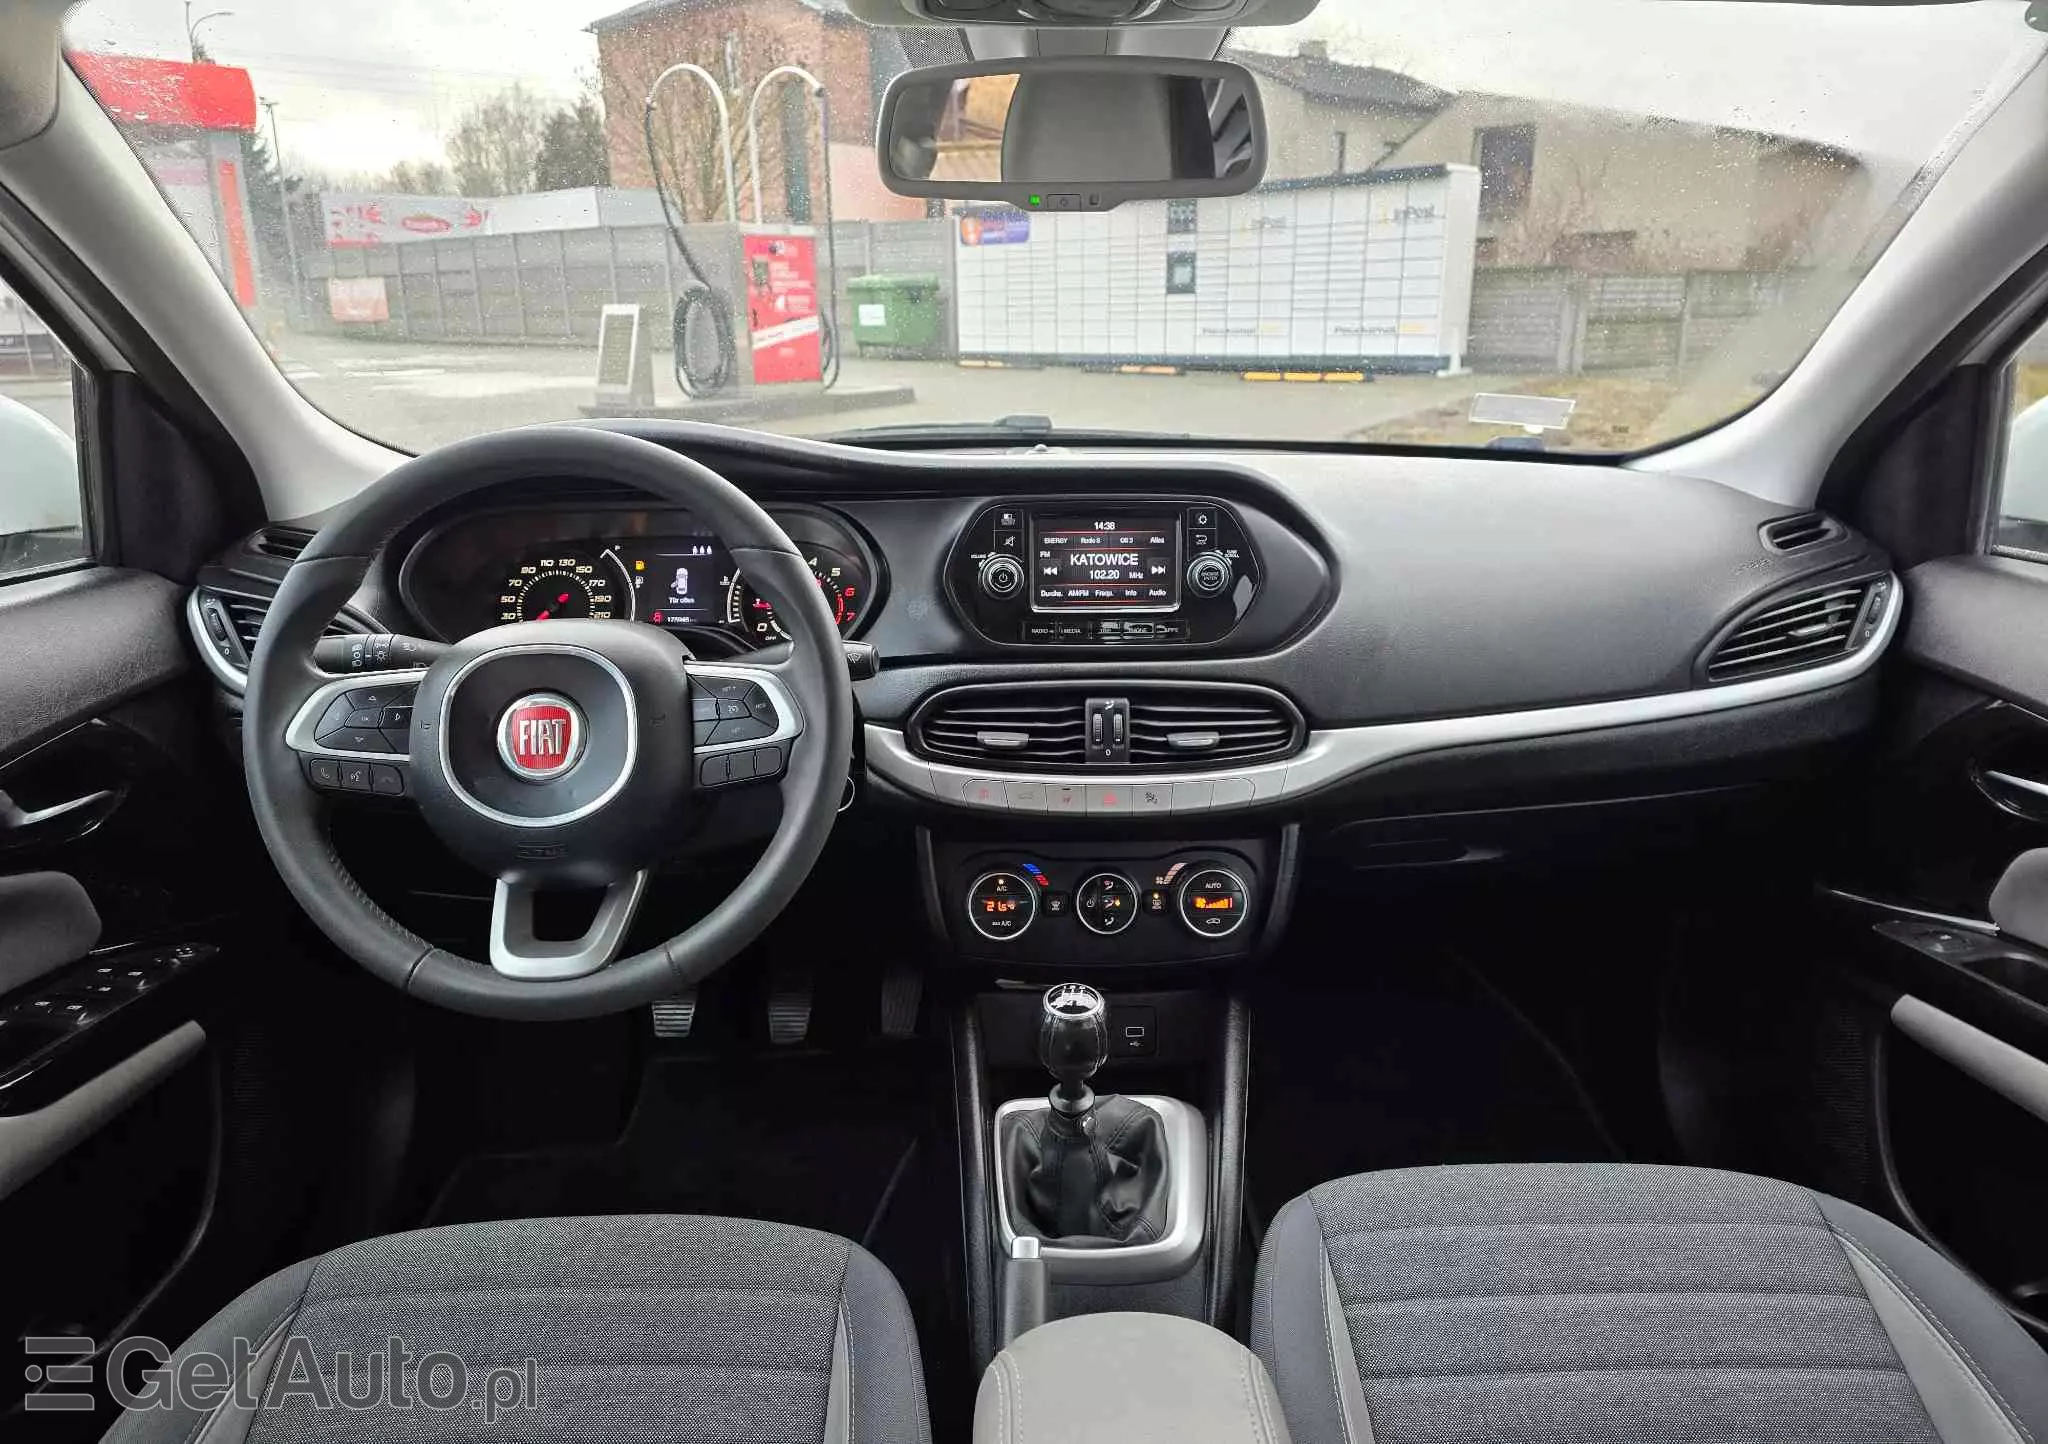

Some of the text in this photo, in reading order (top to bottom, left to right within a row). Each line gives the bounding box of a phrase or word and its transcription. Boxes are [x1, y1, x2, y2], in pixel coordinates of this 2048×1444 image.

[1070, 554, 1139, 566] KATOWICE
[831, 568, 841, 577] 5
[1090, 570, 1120, 580] 102.20
[844, 587, 855, 597] 6
[594, 595, 612, 603] 190
[846, 612, 857, 621] 7
[756, 623, 768, 632] 0
[519, 718, 567, 756] FIAT
